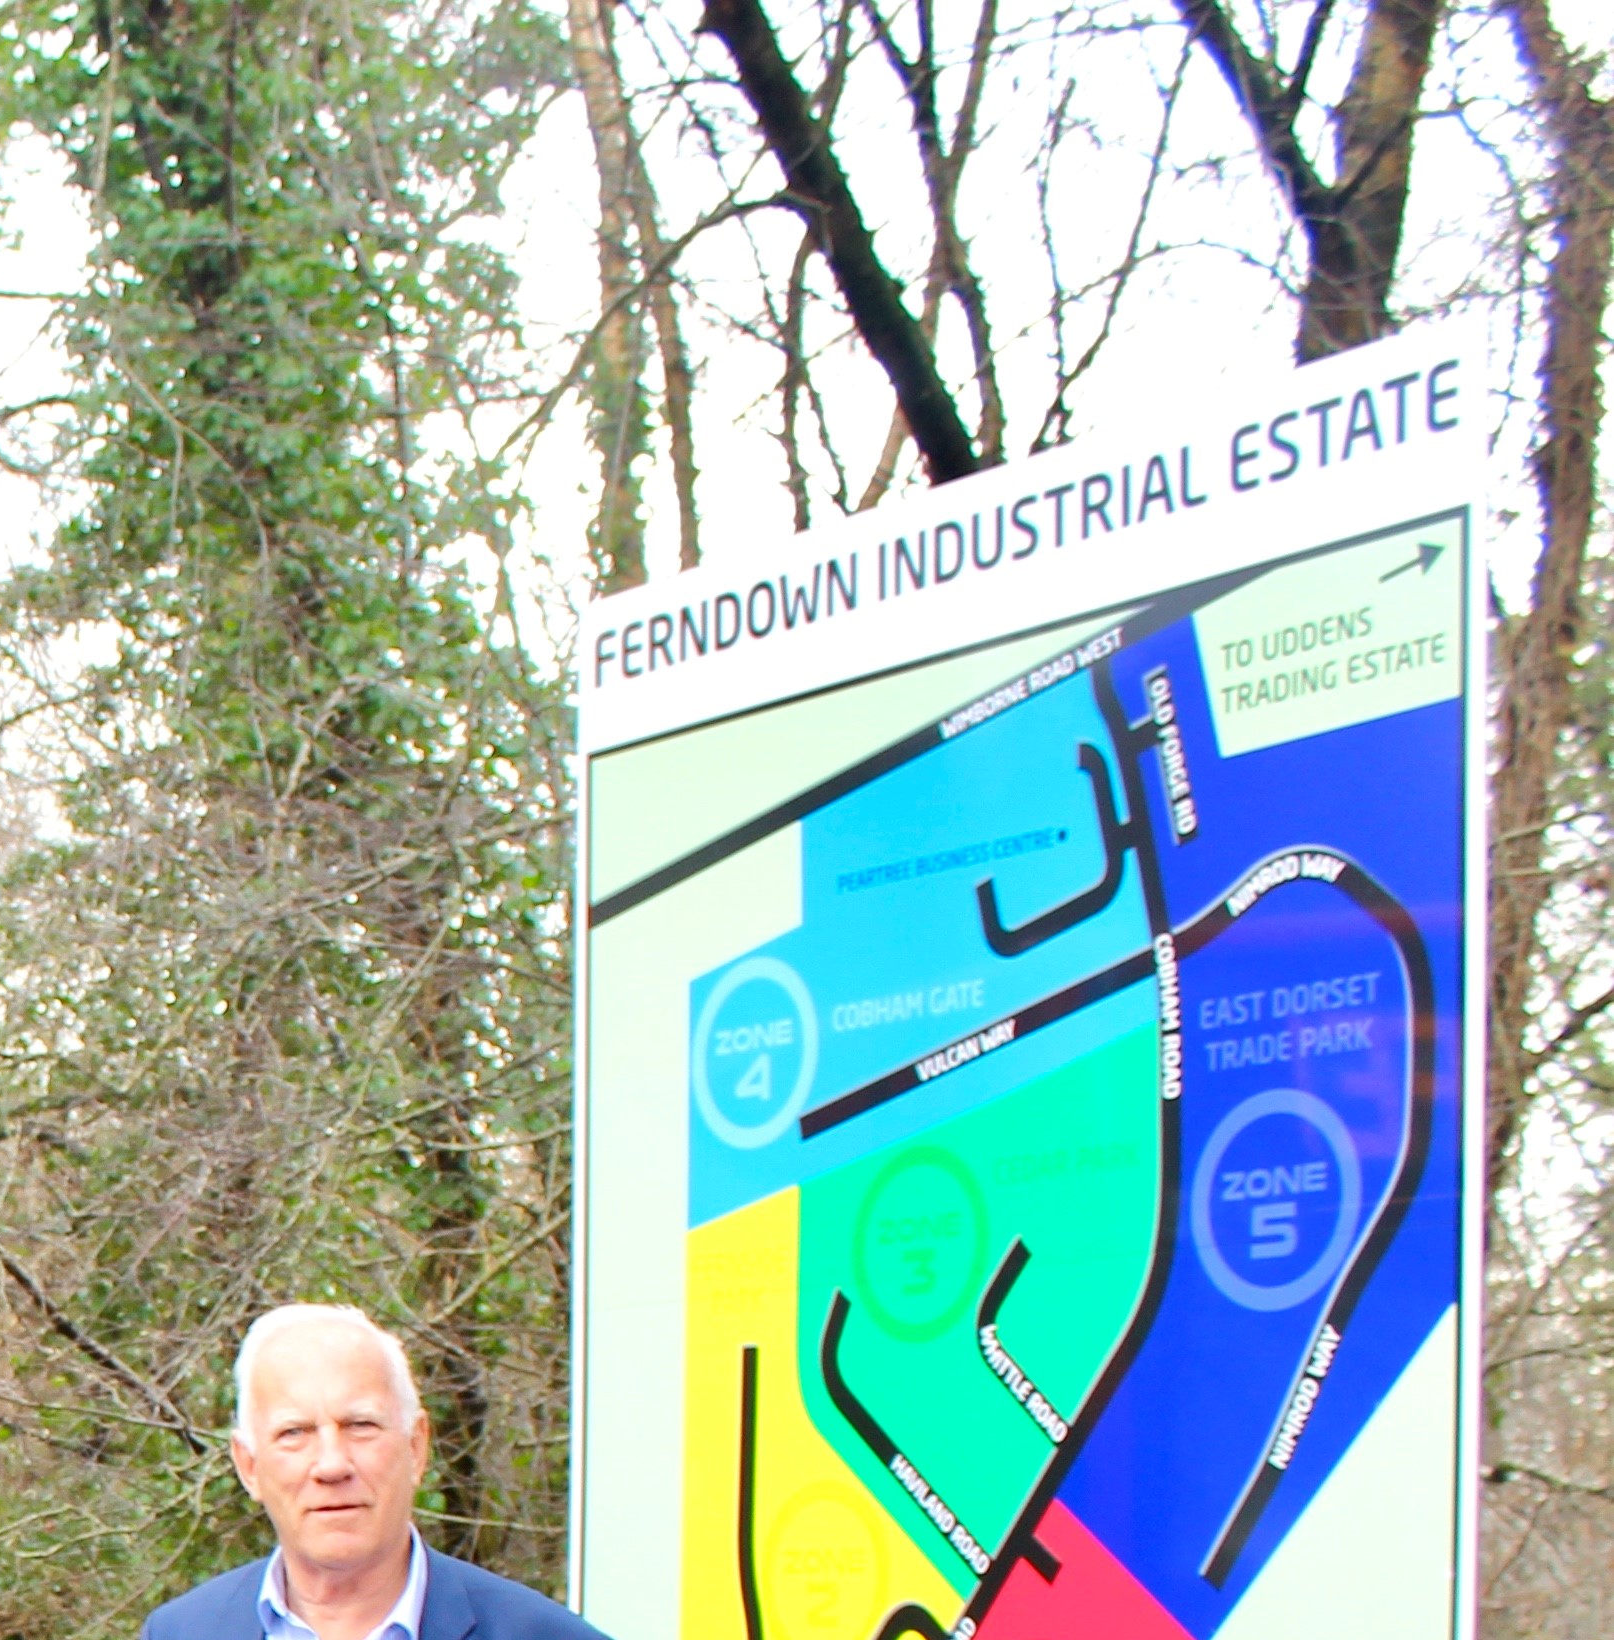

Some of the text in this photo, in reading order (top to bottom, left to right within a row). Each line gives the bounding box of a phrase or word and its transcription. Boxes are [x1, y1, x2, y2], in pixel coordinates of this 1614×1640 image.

[595, 358, 1460, 689] FERNDOWN INDUSTRIAL ESTATE
[1221, 606, 1374, 672] TO UDDENS
[938, 626, 1124, 740] WIMBORNE ROAD WEST
[1221, 632, 1447, 714] TRADING ESTATE
[1225, 853, 1347, 917] NIMROD WAY
[832, 978, 985, 1032] COBHAM GATE
[1200, 972, 1382, 1030] EAST DORSET
[716, 1019, 794, 1056] ZONE
[916, 1018, 1017, 1082] VULCAN WAY
[1161, 1033, 1182, 1100] ROAD
[1204, 1017, 1373, 1072] TRADE PARK
[734, 1053, 772, 1101] 4
[1221, 1162, 1328, 1201] ZONE
[877, 1211, 962, 1245] ZONE
[1249, 1201, 1298, 1260] 5
[902, 1249, 938, 1296] 3
[979, 1324, 1069, 1443] WHITTLE ROAD
[1268, 1323, 1343, 1471] NIMROD WAY
[889, 1453, 992, 1575] HAVILAND ROAD
[784, 1547, 868, 1575] ZONE
[807, 1583, 840, 1628] 2
